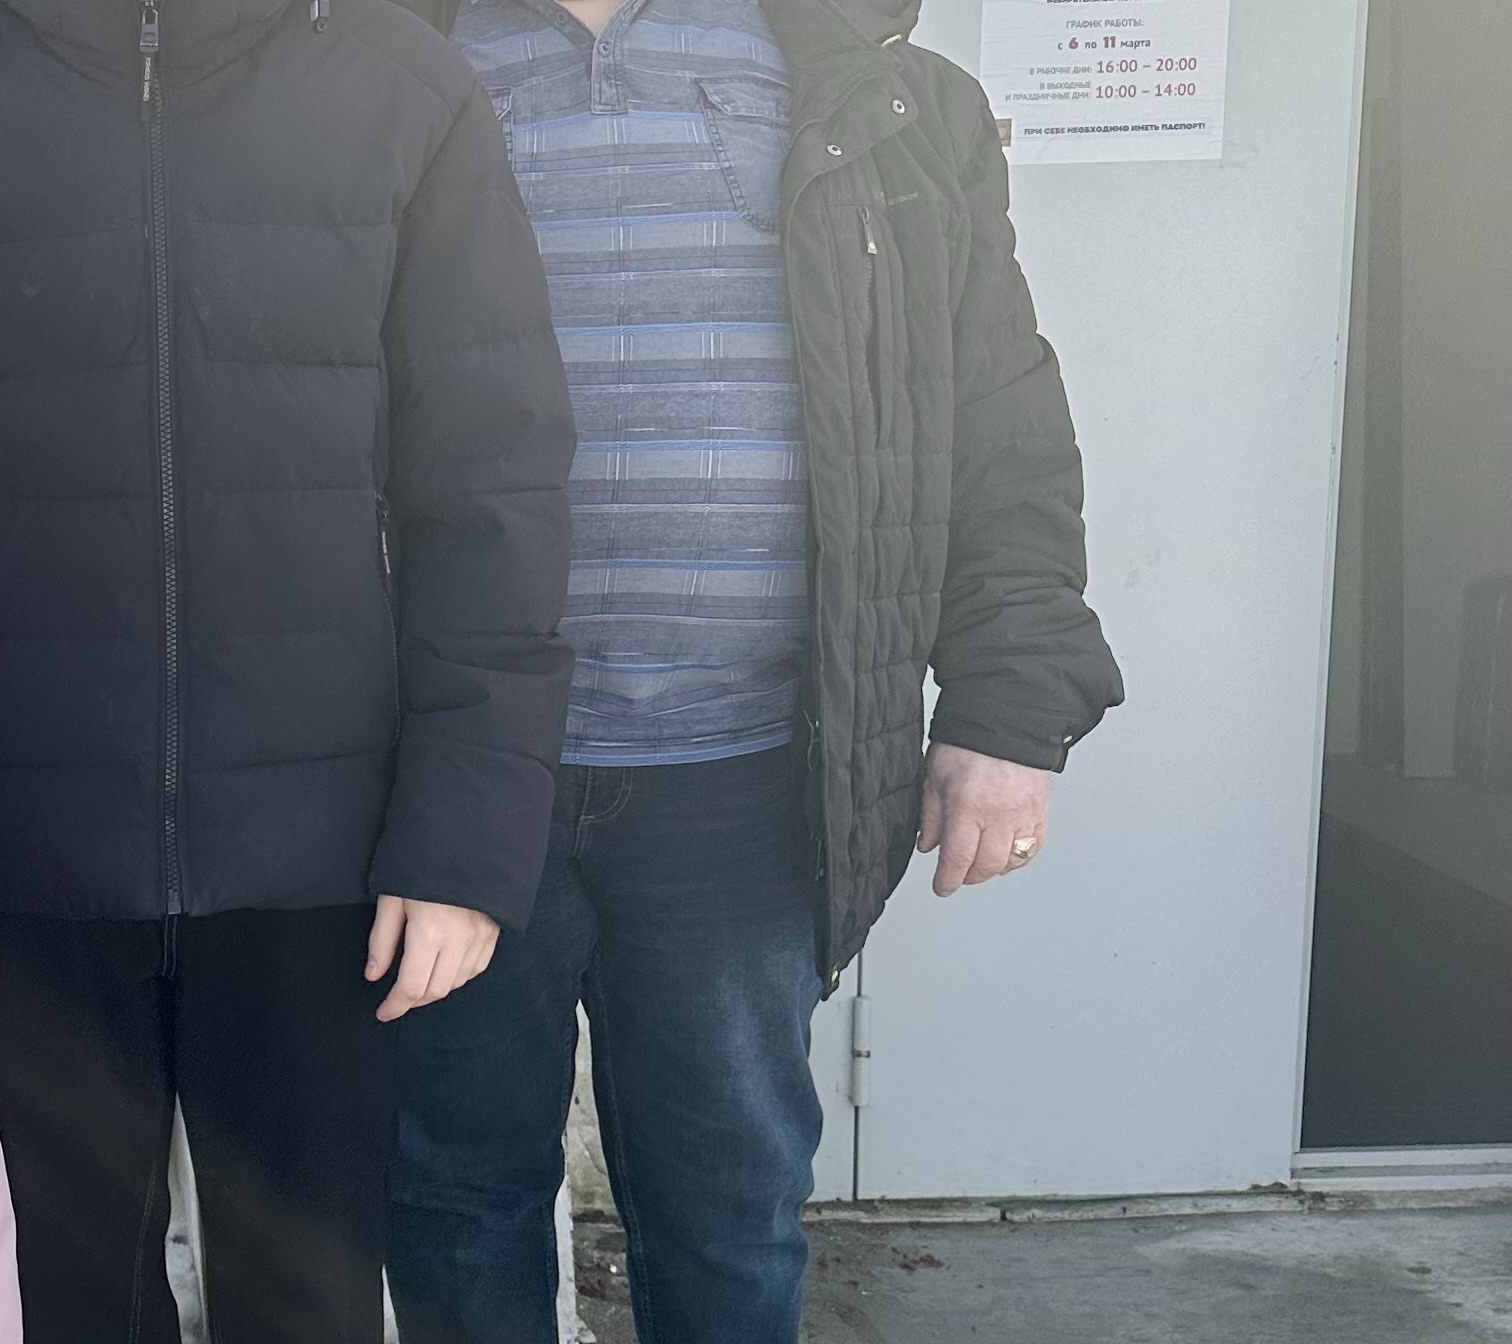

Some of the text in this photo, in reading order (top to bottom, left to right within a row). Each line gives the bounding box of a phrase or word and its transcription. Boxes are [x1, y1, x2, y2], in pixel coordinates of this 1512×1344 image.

[1066, 20, 1102, 29] ГРАФИК
[1068, 37, 1079, 49] 6
[1085, 41, 1097, 49] по
[1103, 36, 1116, 48] 11
[1120, 38, 1151, 50] марта
[1096, 60, 1138, 74] 16:00
[1155, 57, 1197, 72] 20:00
[1096, 85, 1137, 99] 10:00
[1154, 83, 1196, 97] 14:00
